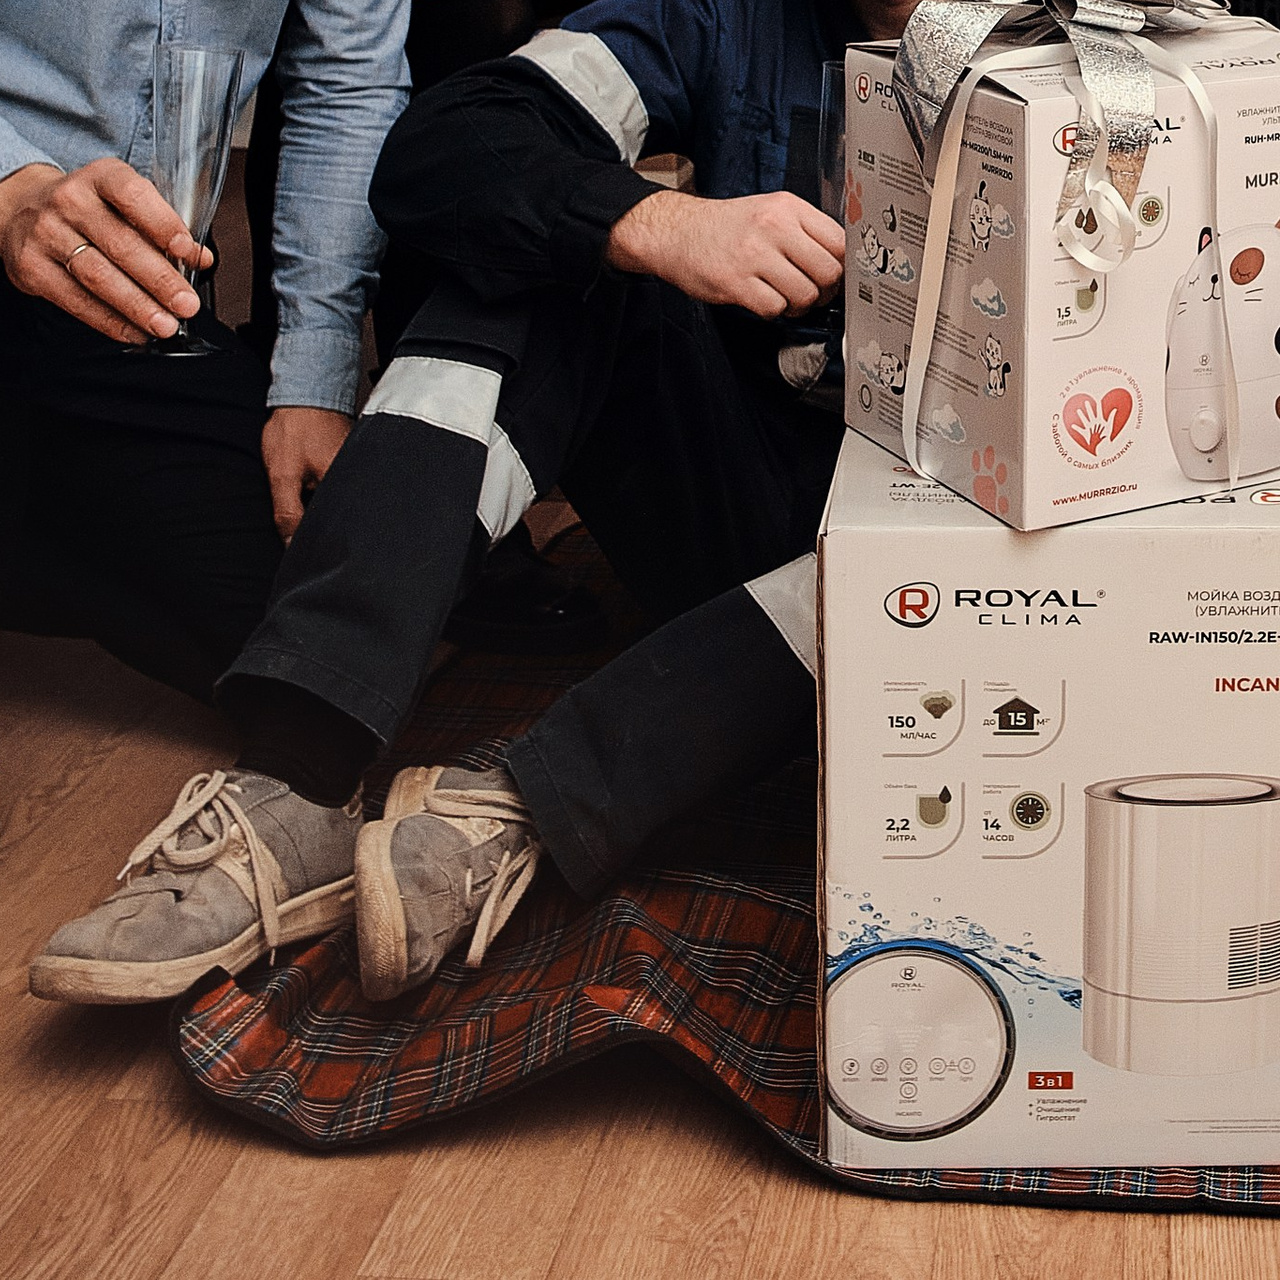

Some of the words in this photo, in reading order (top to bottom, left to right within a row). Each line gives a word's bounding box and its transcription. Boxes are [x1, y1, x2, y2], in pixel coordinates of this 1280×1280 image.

[1056, 307, 1071, 320] 1,5
[1074, 364, 1122, 384] увлажнение
[1051, 422, 1069, 458] заботой
[1073, 460, 1100, 470] самых
[1101, 439, 1134, 467] близких
[1052, 483, 1138, 506] www.MURRRZIO.ru
[1187, 589, 1240, 602] МОЙКА
[978, 614, 1082, 625] CLIMA
[888, 716, 916, 728] 150
[1008, 712, 1026, 726] 15
[900, 732, 937, 740] МЛ/ЧАС
[886, 819, 910, 832] 2,2
[984, 819, 1001, 831] 14
